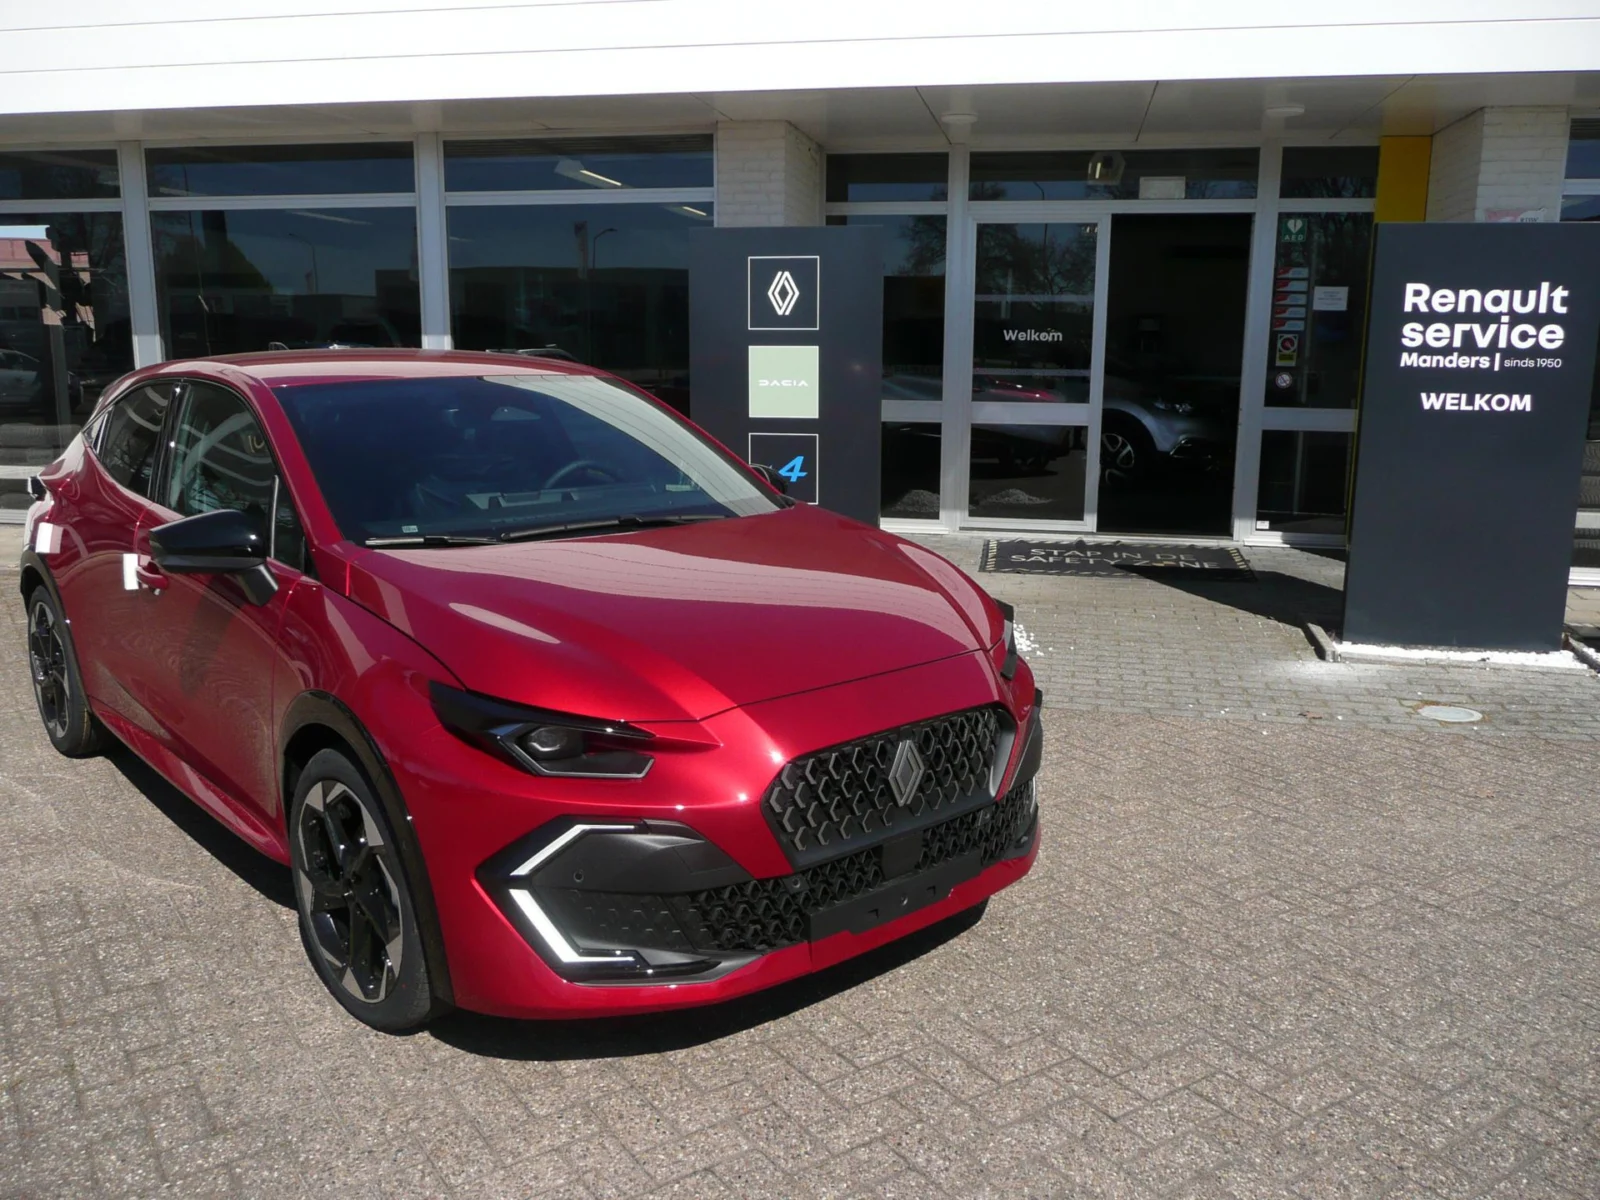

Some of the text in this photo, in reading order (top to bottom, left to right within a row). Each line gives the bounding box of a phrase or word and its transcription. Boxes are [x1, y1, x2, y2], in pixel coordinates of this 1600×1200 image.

[1403, 281, 1569, 314] Renault
[1003, 328, 1063, 342] Welkom
[1401, 315, 1565, 349] service
[1400, 352, 1562, 369] Manders sinds 1950
[758, 379, 809, 387] DACIA
[1420, 392, 1532, 412] WELKOM
[1011, 555, 1121, 565] SAFETY
[1030, 548, 1197, 561] STAP IN DE
